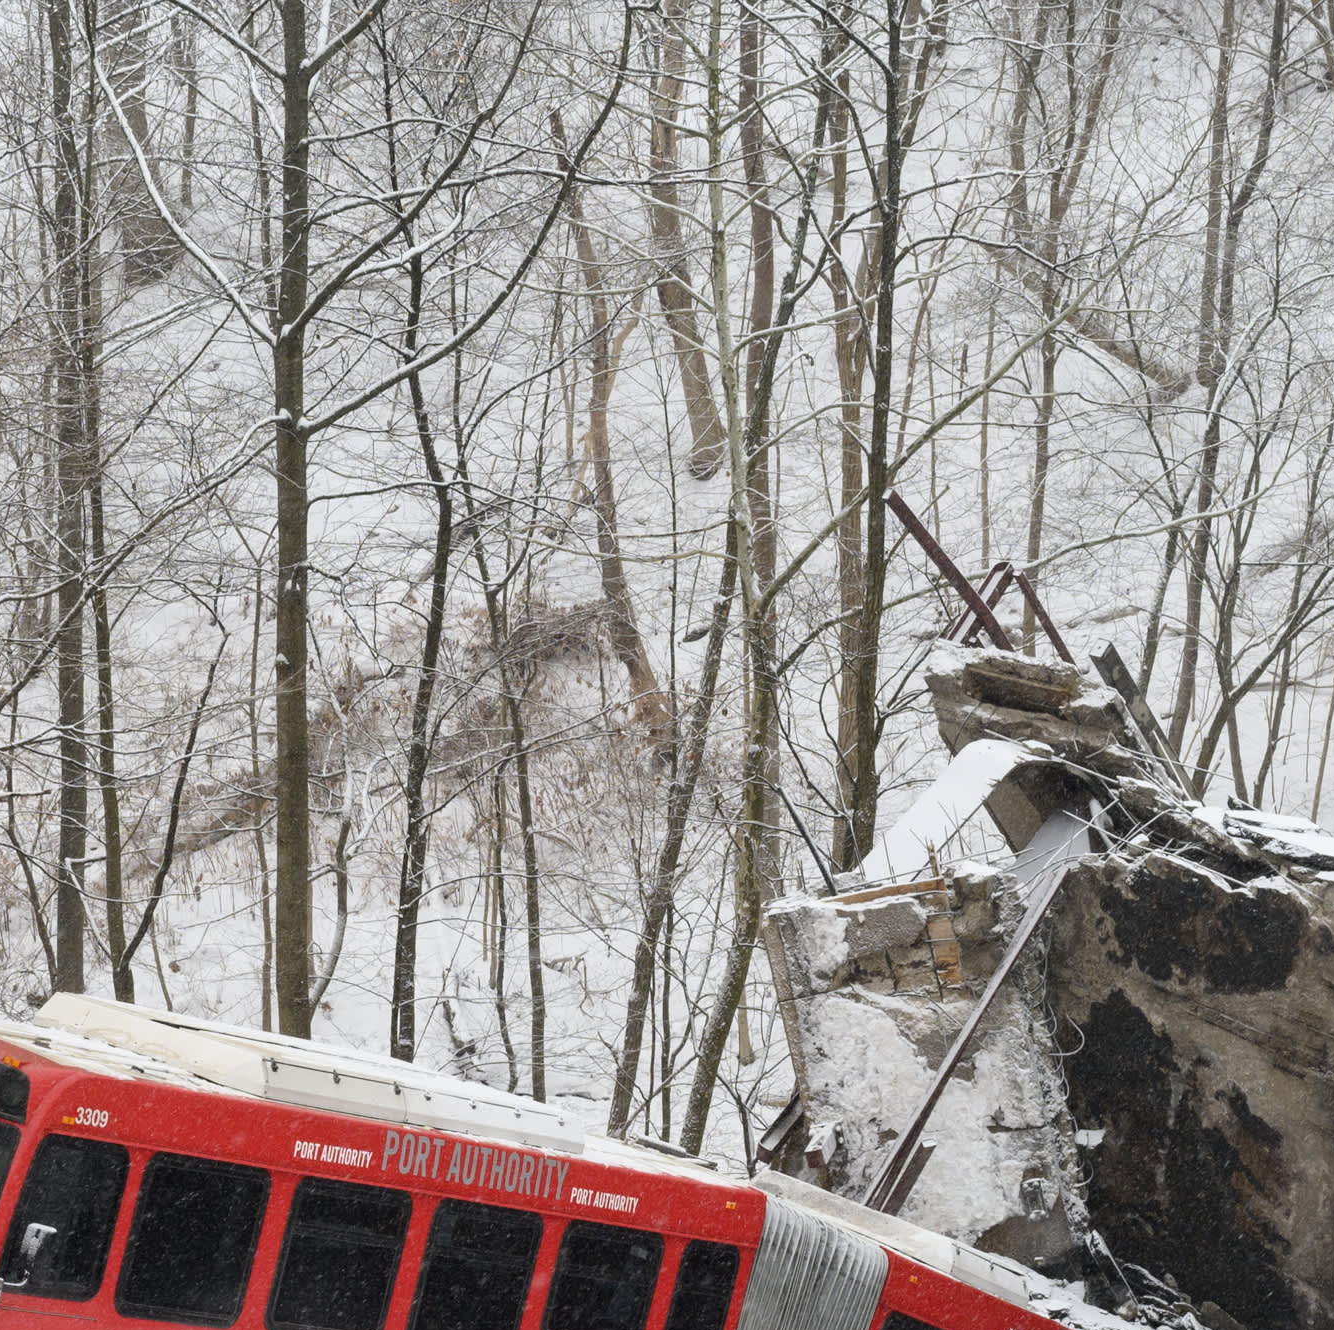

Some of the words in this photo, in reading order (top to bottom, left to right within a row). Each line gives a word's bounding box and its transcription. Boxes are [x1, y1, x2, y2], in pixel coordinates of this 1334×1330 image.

[75, 1106, 109, 1128] 3309
[293, 1140, 321, 1161] PORT
[320, 1144, 373, 1169] AUTHORITY
[381, 1130, 445, 1179] PORT
[445, 1142, 570, 1201] AUTHORITY
[570, 1187, 595, 1206] PORT
[593, 1191, 639, 1214] AUTHORITY
